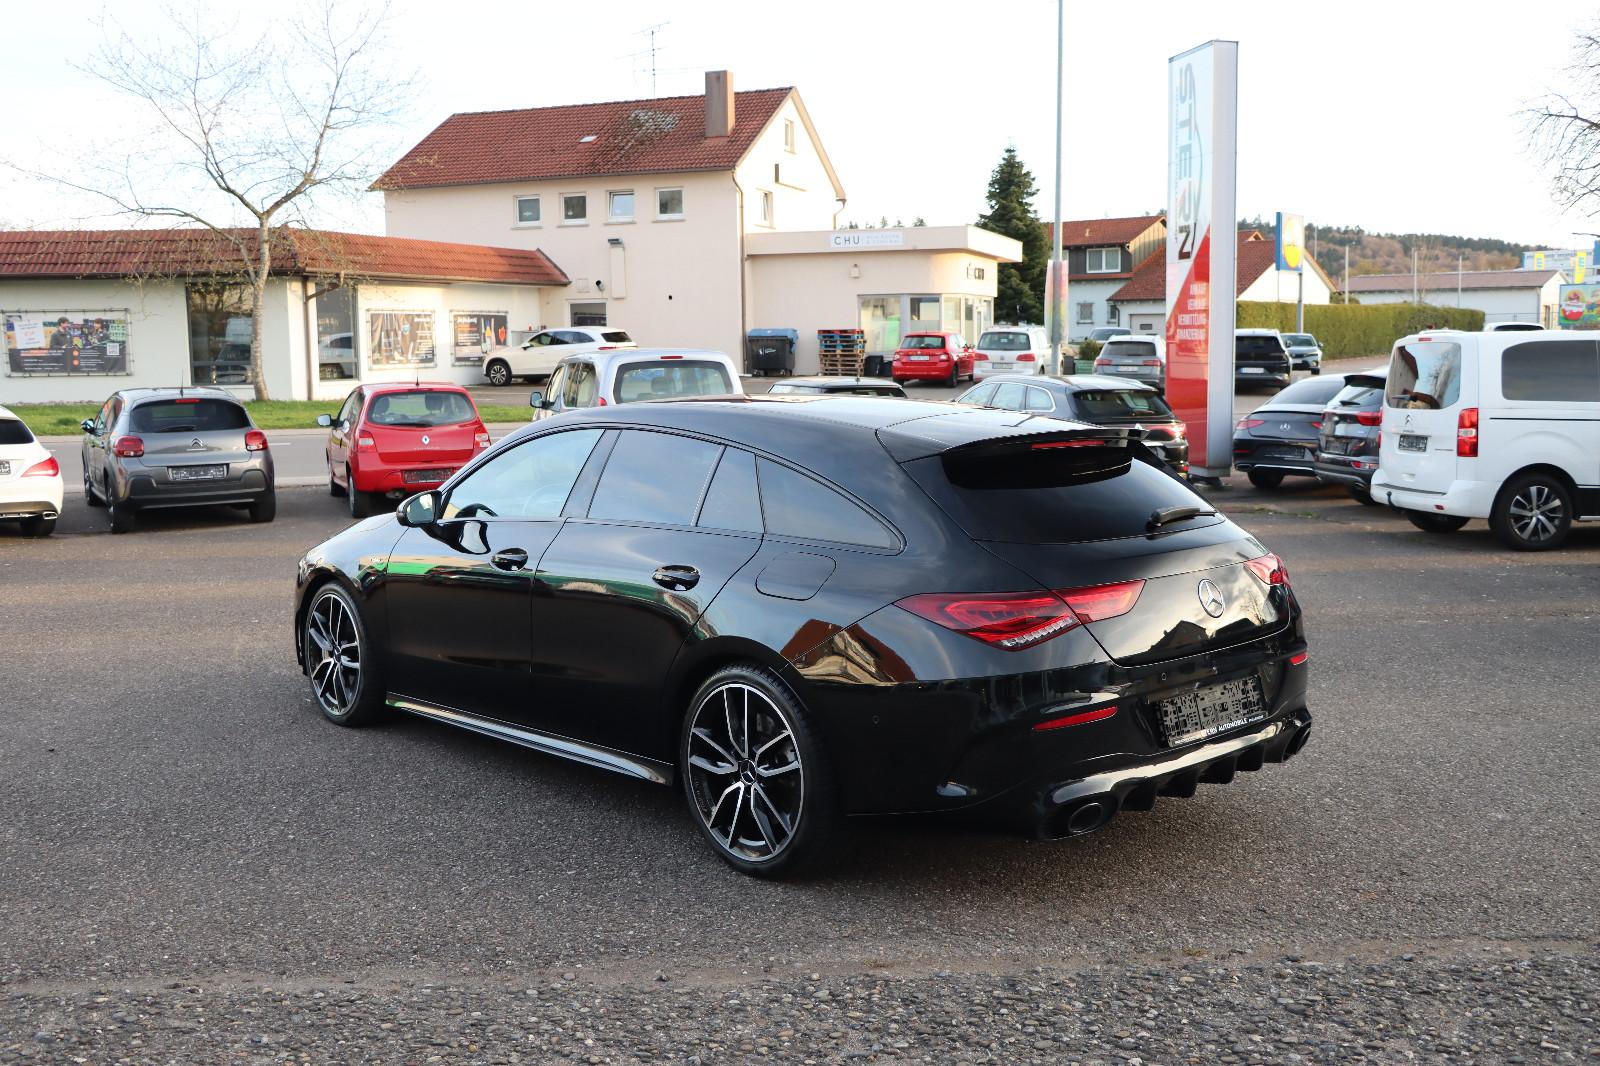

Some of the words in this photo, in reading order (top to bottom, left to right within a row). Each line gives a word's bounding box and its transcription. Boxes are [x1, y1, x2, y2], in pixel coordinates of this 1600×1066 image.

[1178, 62, 1193, 260] STERN
[834, 235, 860, 245] CHU
[1218, 718, 1248, 732] AUTOMOBILE
